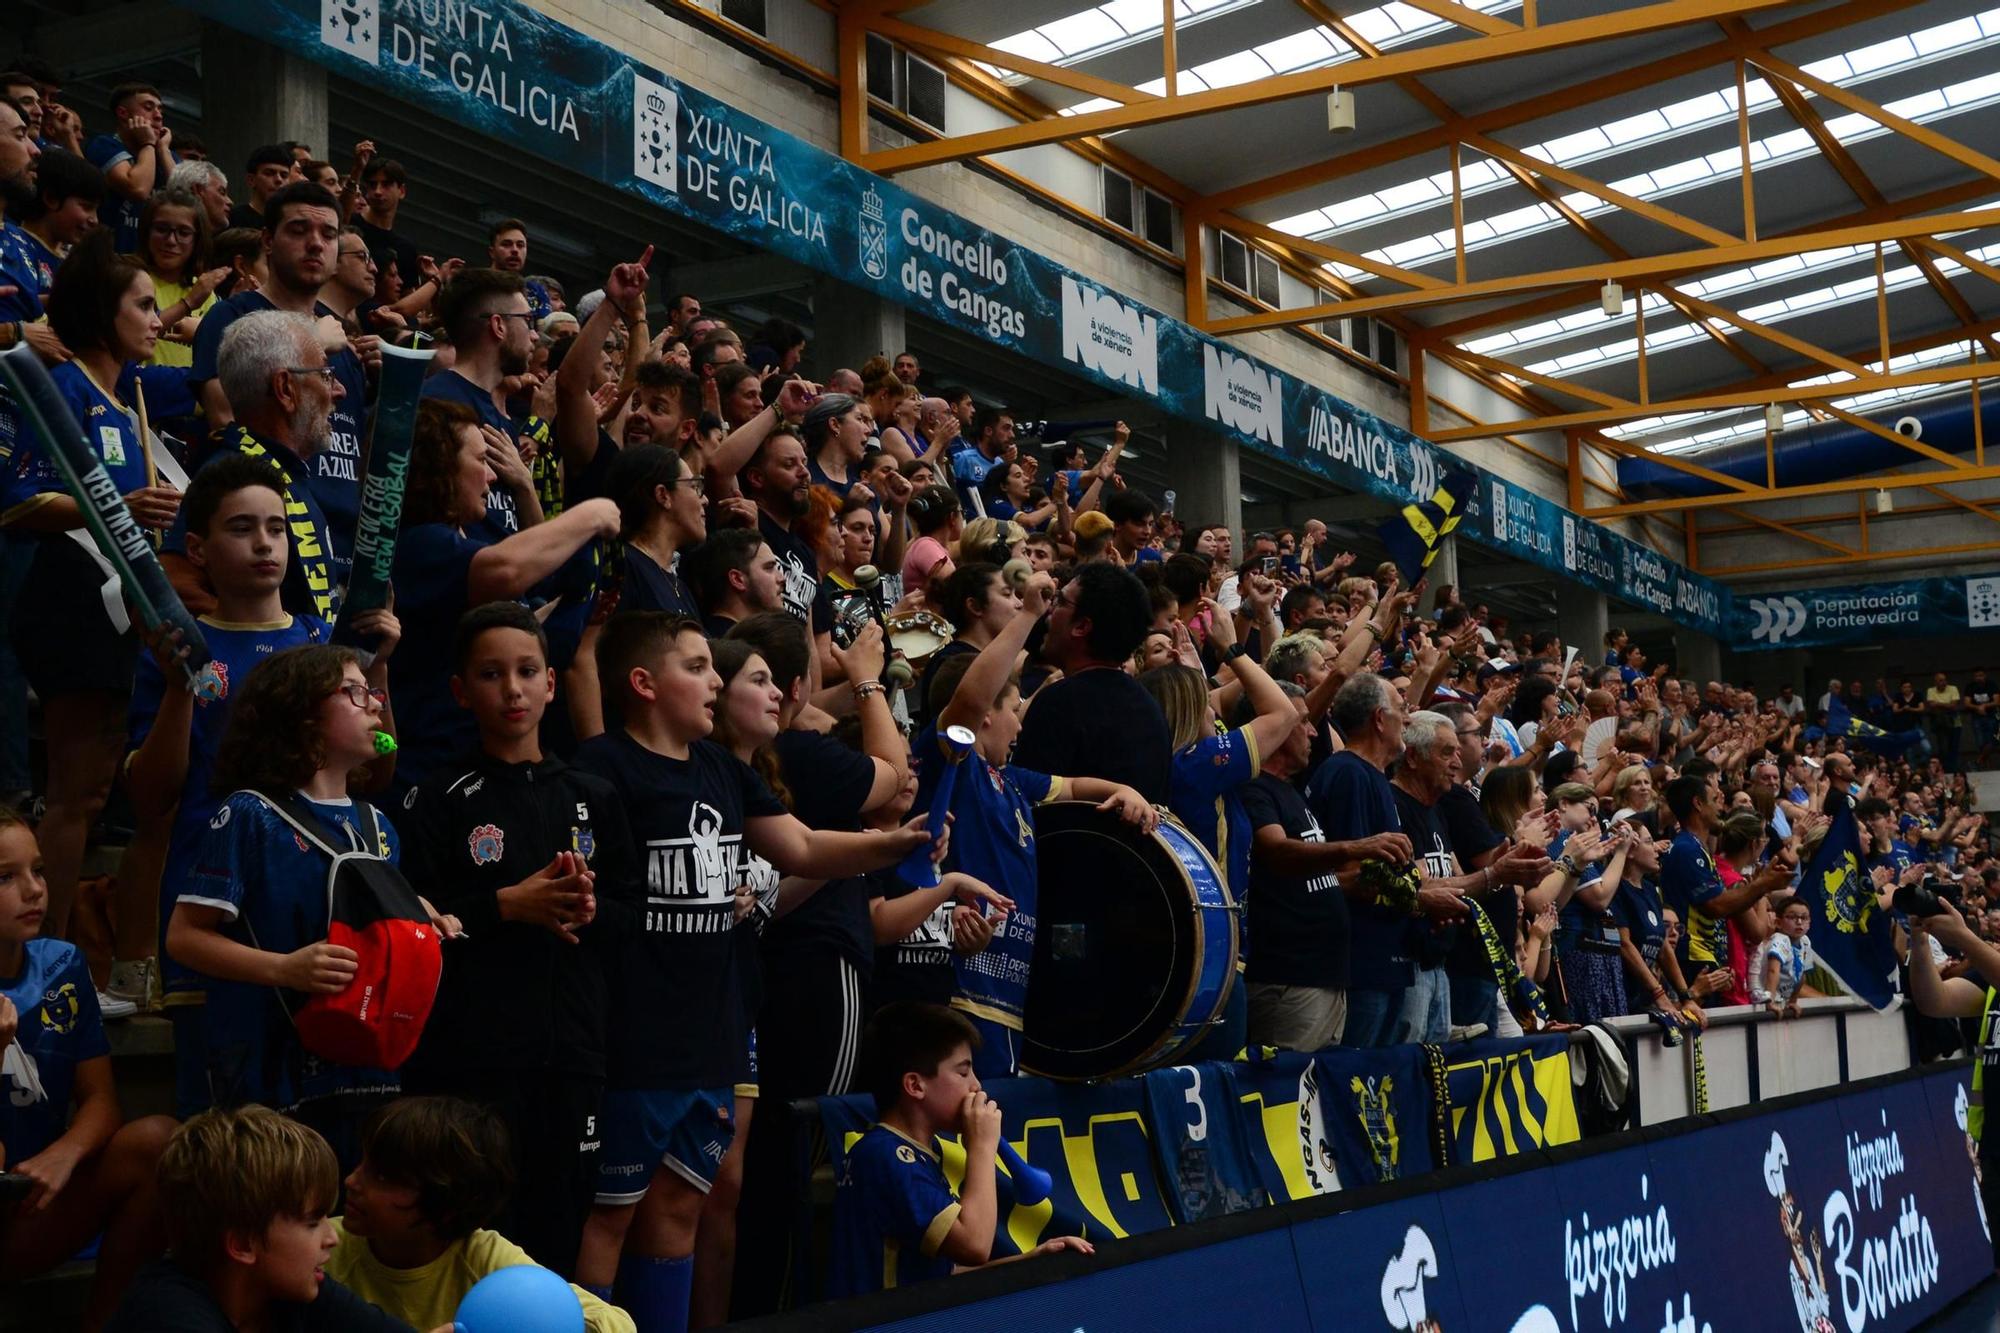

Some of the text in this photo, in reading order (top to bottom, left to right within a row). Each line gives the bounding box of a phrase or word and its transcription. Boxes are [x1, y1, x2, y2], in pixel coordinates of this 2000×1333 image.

[393, 23, 579, 142] DE GALICIA
[687, 109, 775, 182] XUNTA
[687, 157, 826, 247] DE GALICIA
[901, 207, 1007, 286] Concello
[901, 257, 1026, 338] de Cangas
[1061, 275, 1158, 396] NON
[1091, 331, 1102, 344] de
[1097, 321, 1133, 346] violencia
[1203, 343, 1283, 448] NON
[317, 454, 359, 482] AZUL
[80, 462, 150, 560] NEW ERA
[355, 472, 386, 559] NEW ERA
[1508, 494, 1536, 522] XUNTA
[1508, 521, 1552, 556] DE GALICIA
[1576, 527, 1601, 554] XUNTA
[371, 534, 396, 583] NEW
[1577, 550, 1616, 582] DE GALICIA
[1634, 551, 1666, 584] Concello
[1635, 578, 1672, 613] de Cangas
[1815, 589, 1918, 615] Deputación
[1816, 609, 1919, 629] Pontevedra
[575, 801, 589, 822] 5
[585, 1115, 597, 1137] 5
[599, 1161, 644, 1177] Kempa
[1846, 1108, 1905, 1212] pizzeria
[1564, 1173, 1676, 1333] pizzeria
